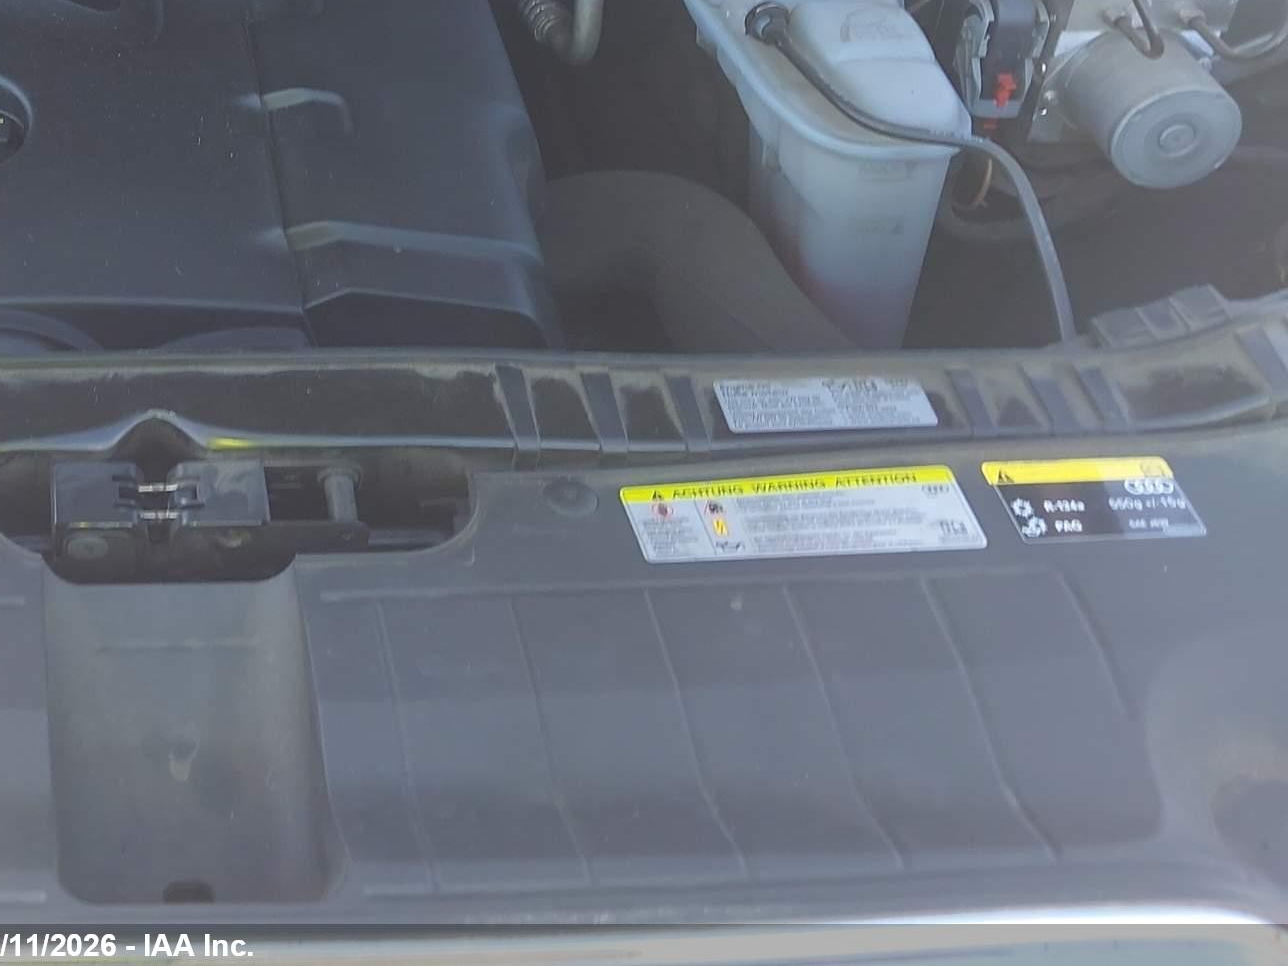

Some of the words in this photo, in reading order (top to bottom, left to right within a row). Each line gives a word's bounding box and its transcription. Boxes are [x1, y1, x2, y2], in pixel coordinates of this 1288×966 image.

[672, 485, 744, 499] ACHTUNG
[752, 478, 826, 494] WARNING
[835, 472, 917, 489] ATTENTION
